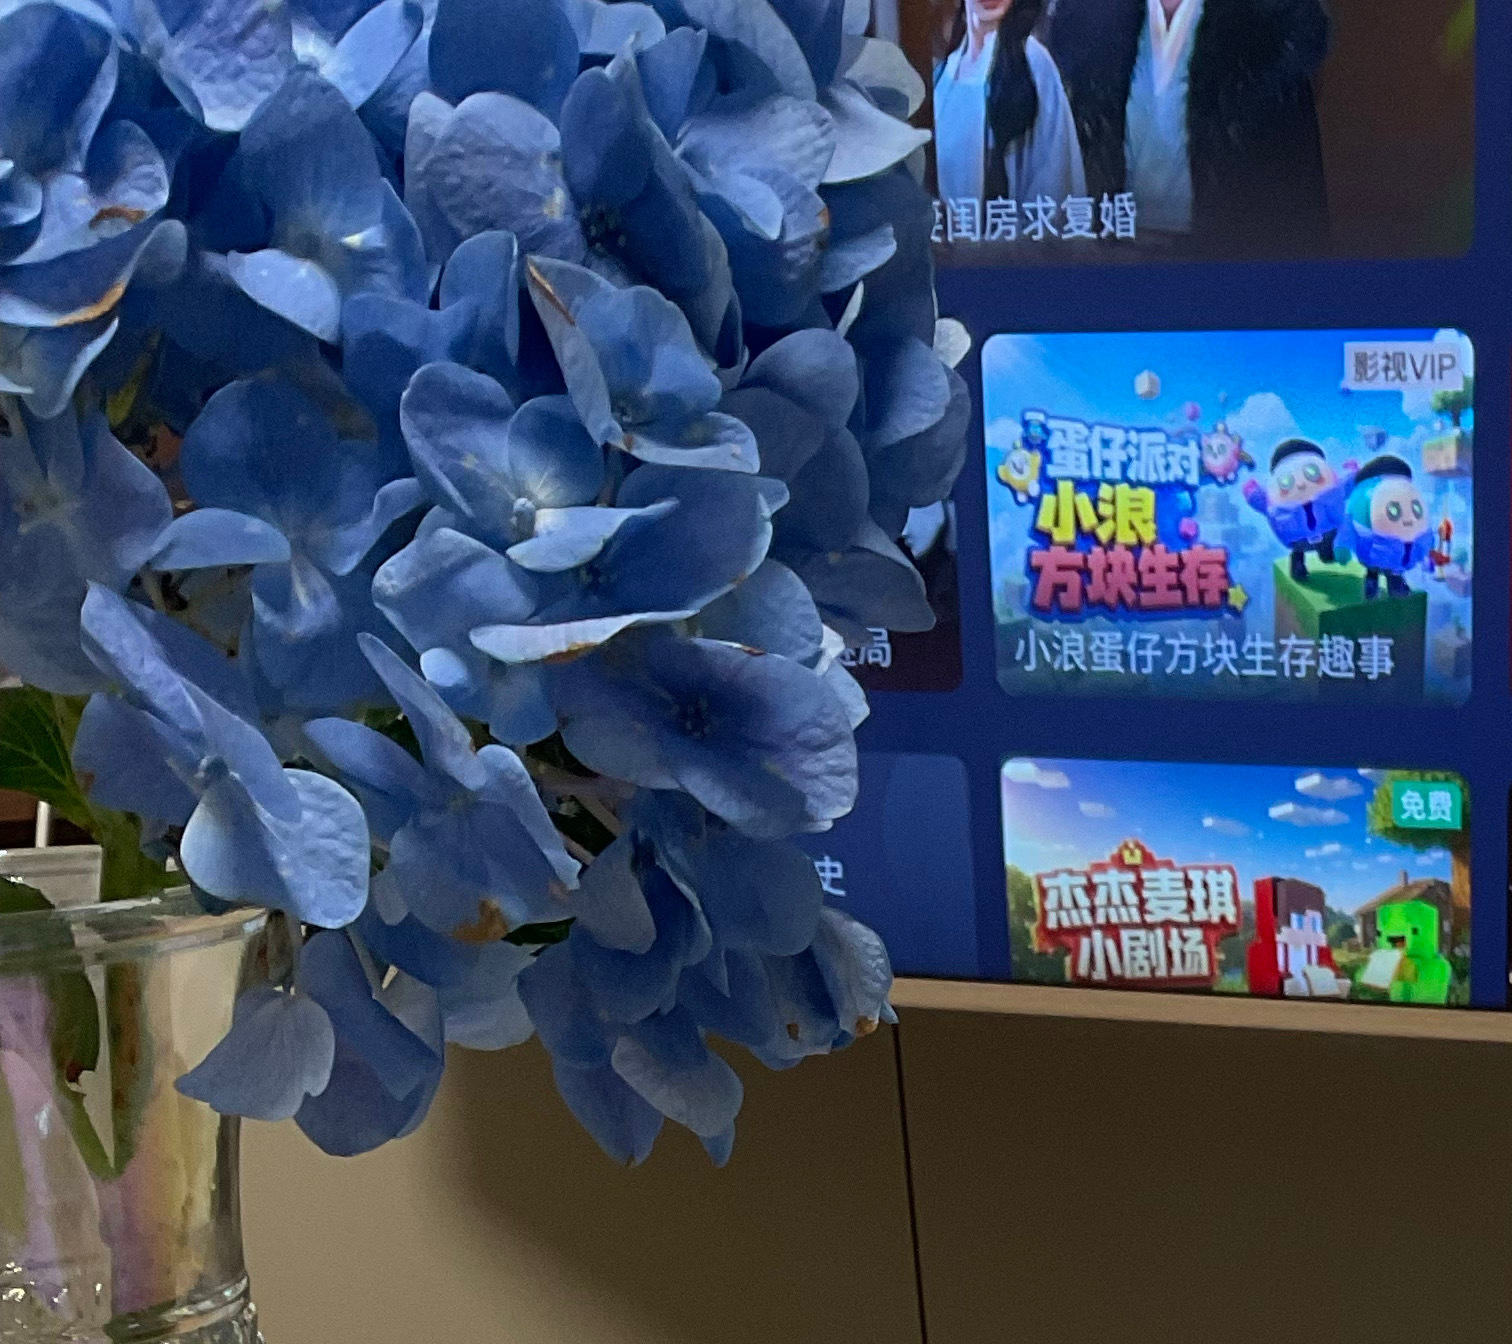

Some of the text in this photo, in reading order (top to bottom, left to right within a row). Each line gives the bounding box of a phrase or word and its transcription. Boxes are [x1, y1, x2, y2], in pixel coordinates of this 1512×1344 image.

[1353, 351, 1457, 382] 影视VIP
[1045, 416, 1200, 485] 蛋仔派对
[1035, 480, 1157, 546] 小浪
[1030, 544, 1230, 614] 方块生存
[838, 626, 892, 668] 局
[1013, 628, 1395, 682] 小浪蛋仔方块生存趣事
[1399, 788, 1454, 823] 免费
[1043, 868, 1237, 930] 杰杰麦琪
[1077, 926, 1210, 981] 小剧场
